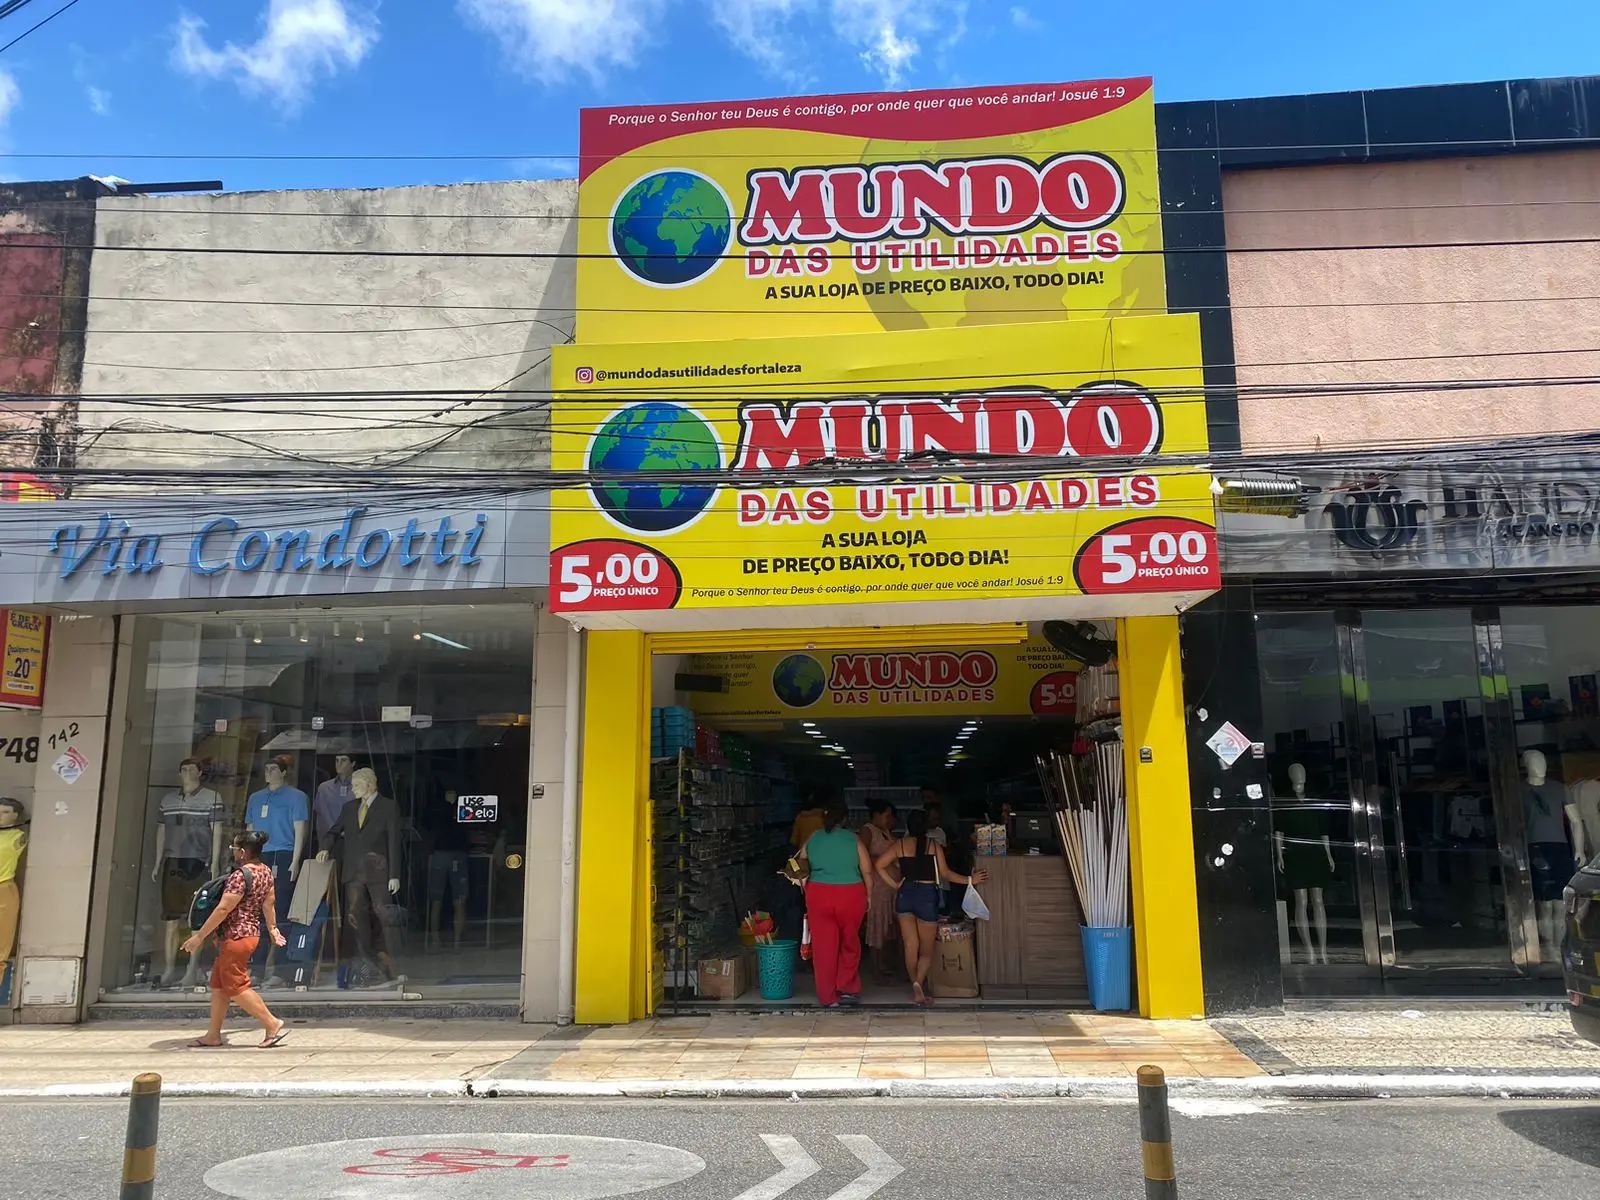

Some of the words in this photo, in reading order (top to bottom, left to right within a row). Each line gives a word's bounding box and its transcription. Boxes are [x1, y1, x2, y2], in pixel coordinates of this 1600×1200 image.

[609, 114, 655, 126] Porque
[658, 115, 667, 123] o
[670, 110, 718, 122] Senhor
[721, 109, 742, 120] teu
[745, 107, 779, 118] Deus
[783, 105, 791, 116] é
[795, 103, 846, 116] contigo,
[851, 101, 874, 115] por
[877, 99, 910, 111] onde
[914, 98, 944, 111] quer
[948, 97, 973, 109] que
[977, 93, 1008, 105] você
[1012, 91, 1056, 104] andar!
[1059, 88, 1098, 102] Josué
[1102, 86, 1125, 99] 1:9
[740, 153, 1123, 244] MUNDO
[746, 246, 832, 278] DAS
[853, 230, 1121, 274] UTILIDADES
[765, 286, 778, 299] A
[780, 284, 817, 299] SUA
[819, 282, 860, 299] LOJA
[862, 282, 886, 296] DE
[889, 278, 946, 297] PREÇO
[950, 276, 1010, 293] BAIXO,
[1013, 273, 1064, 288] TODO
[1068, 271, 1104, 286] DIA!
[596, 363, 801, 382] @mundodasutilidadesfortaleza
[730, 383, 1161, 484] MUNDO
[738, 487, 832, 524] DAS
[857, 475, 1159, 521] UTILIDADES
[50, 511, 163, 579] Via
[188, 505, 488, 576] Condotti
[822, 534, 836, 548] A
[838, 532, 880, 547] SUA
[882, 529, 927, 547] LOJA
[743, 558, 768, 574] DE
[773, 556, 835, 575] PREÇO
[839, 554, 906, 573] BAIXO,
[909, 551, 967, 568] TODO
[969, 549, 1010, 566] DIA!
[1101, 529, 1207, 584] 5,00
[560, 552, 659, 603] 5,00
[1138, 566, 1173, 579] PREÇO
[1175, 562, 1209, 576] ÚNICO
[593, 586, 626, 599] PREÇO
[627, 584, 658, 597] ÚNICO
[692, 589, 726, 600] Porque
[728, 589, 735, 597] o
[736, 586, 771, 597] Senhor
[790, 585, 815, 595] Deus
[817, 584, 824, 594] é
[866, 584, 882, 593] por
[884, 582, 909, 591] onde
[911, 582, 933, 592] quer
[935, 581, 954, 591] que
[955, 579, 980, 589] você
[981, 577, 1013, 588] andar!
[1014, 575, 1045, 587] Josué
[1047, 575, 1064, 586] 1:9
[14, 657, 30, 679] 20
[830, 651, 996, 689] MUNDO
[833, 690, 869, 704] DAS
[880, 689, 995, 704] UTILIDADES
[463, 796, 485, 806] use
[475, 807, 494, 818] elo
